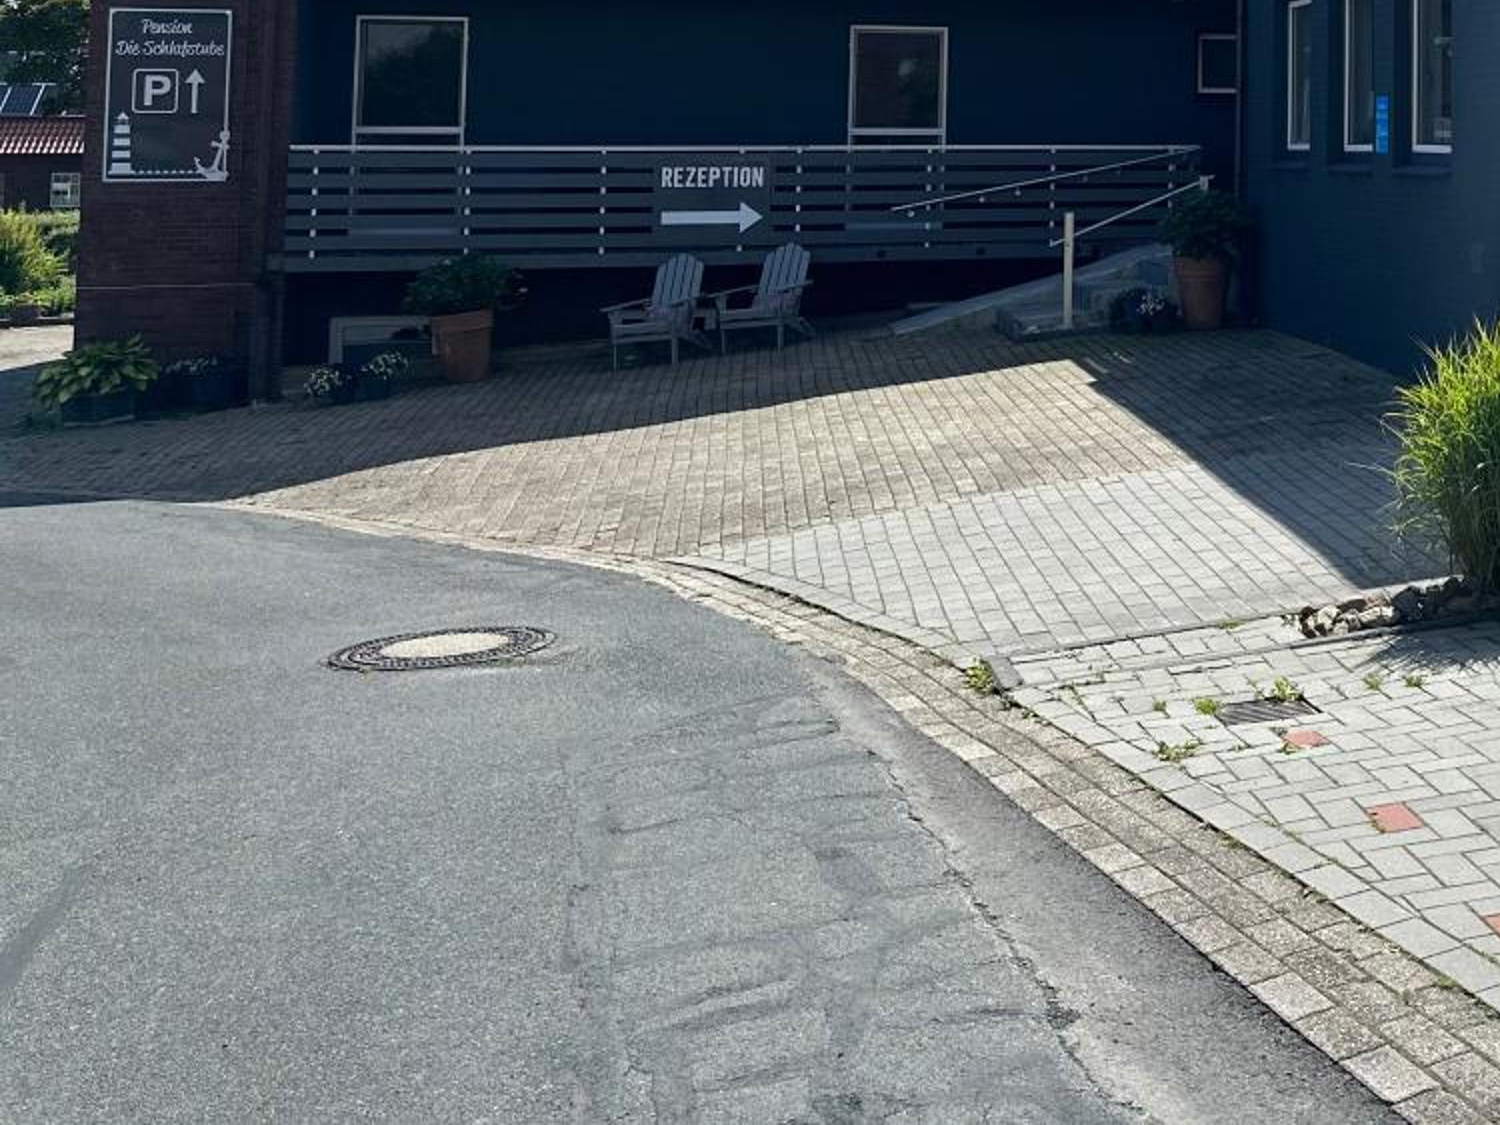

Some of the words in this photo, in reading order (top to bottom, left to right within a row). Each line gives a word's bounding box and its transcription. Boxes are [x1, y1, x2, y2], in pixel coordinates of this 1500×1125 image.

[141, 18, 193, 34] Pension
[115, 40, 140, 56] Die
[143, 41, 225, 58] Schlafstube
[143, 74, 171, 106] P
[661, 166, 764, 188] REZEPTION
